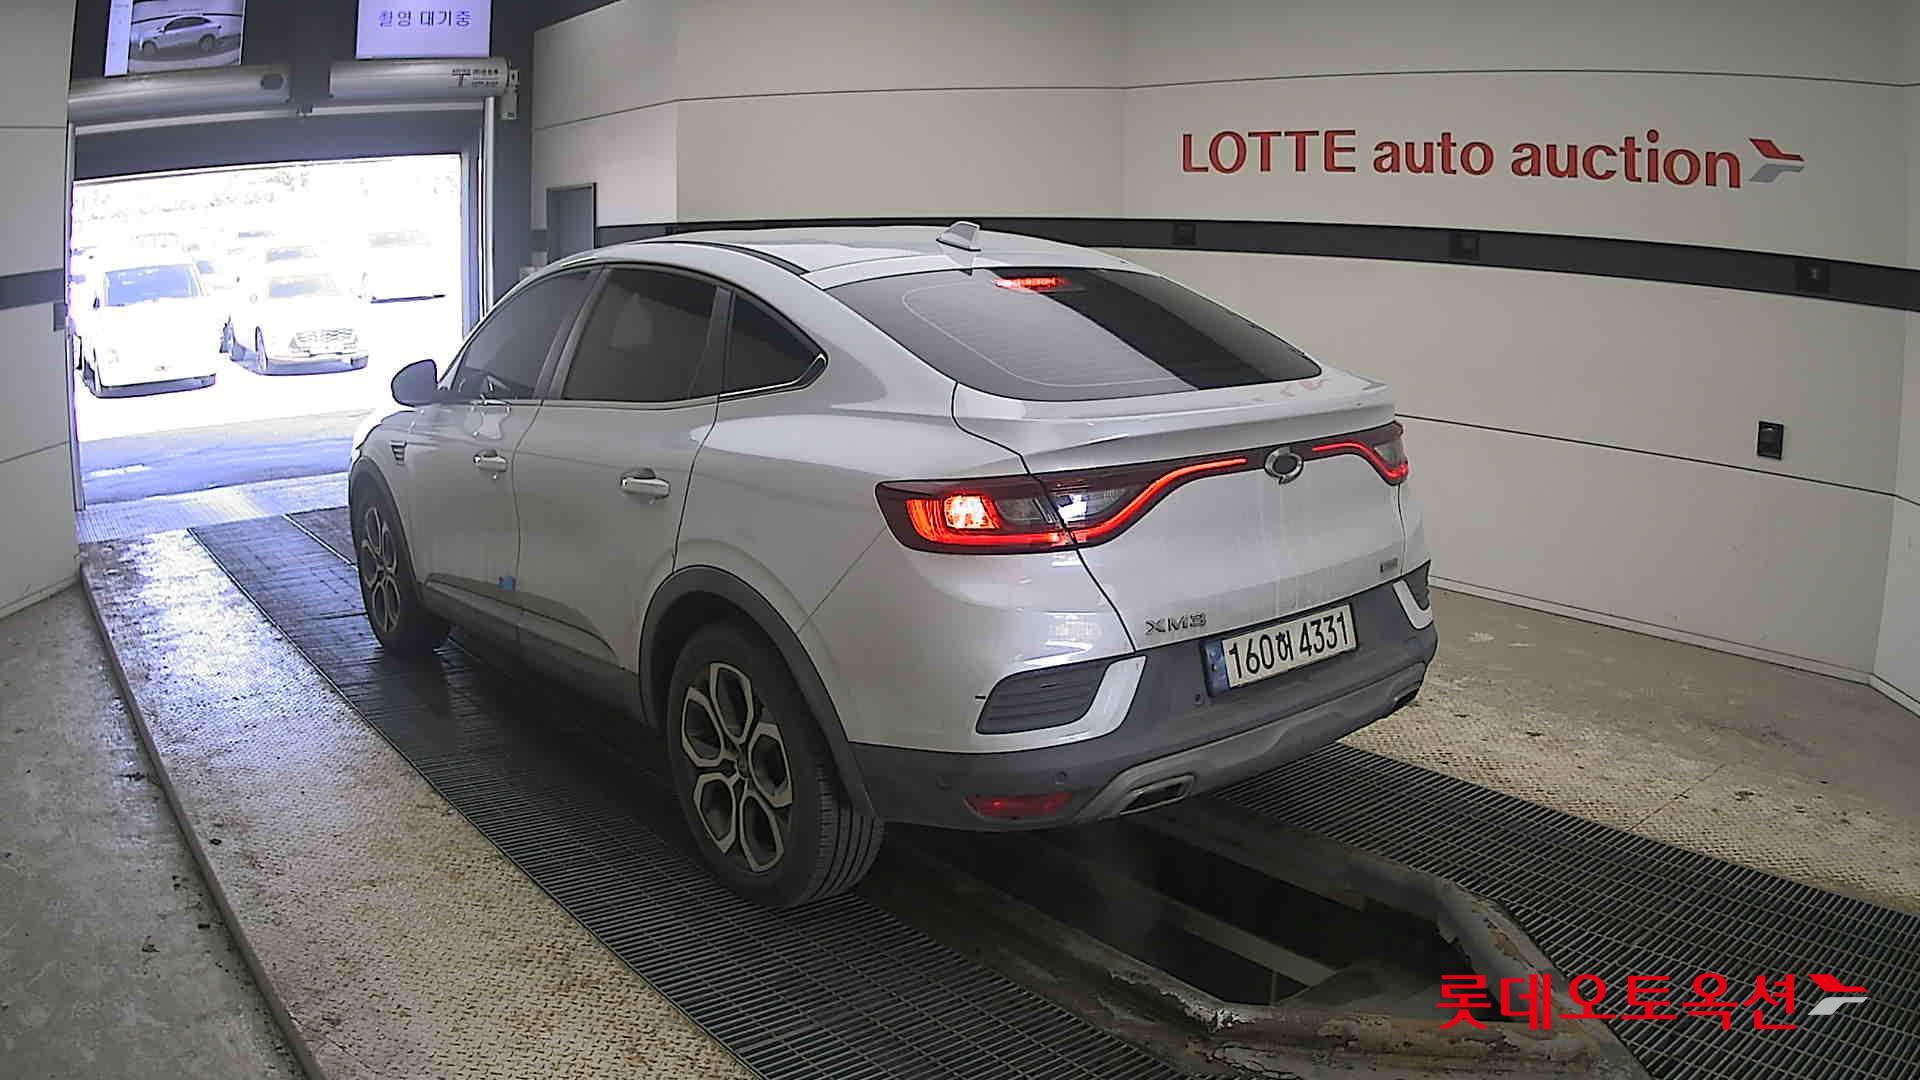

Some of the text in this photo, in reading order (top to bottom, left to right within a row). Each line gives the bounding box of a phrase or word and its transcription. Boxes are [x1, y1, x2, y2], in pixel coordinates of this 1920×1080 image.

[420, 10, 472, 27] 대기중
[1182, 129, 1742, 189] LOTTE auto auction
[1228, 611, 1348, 679] 160허 4331
